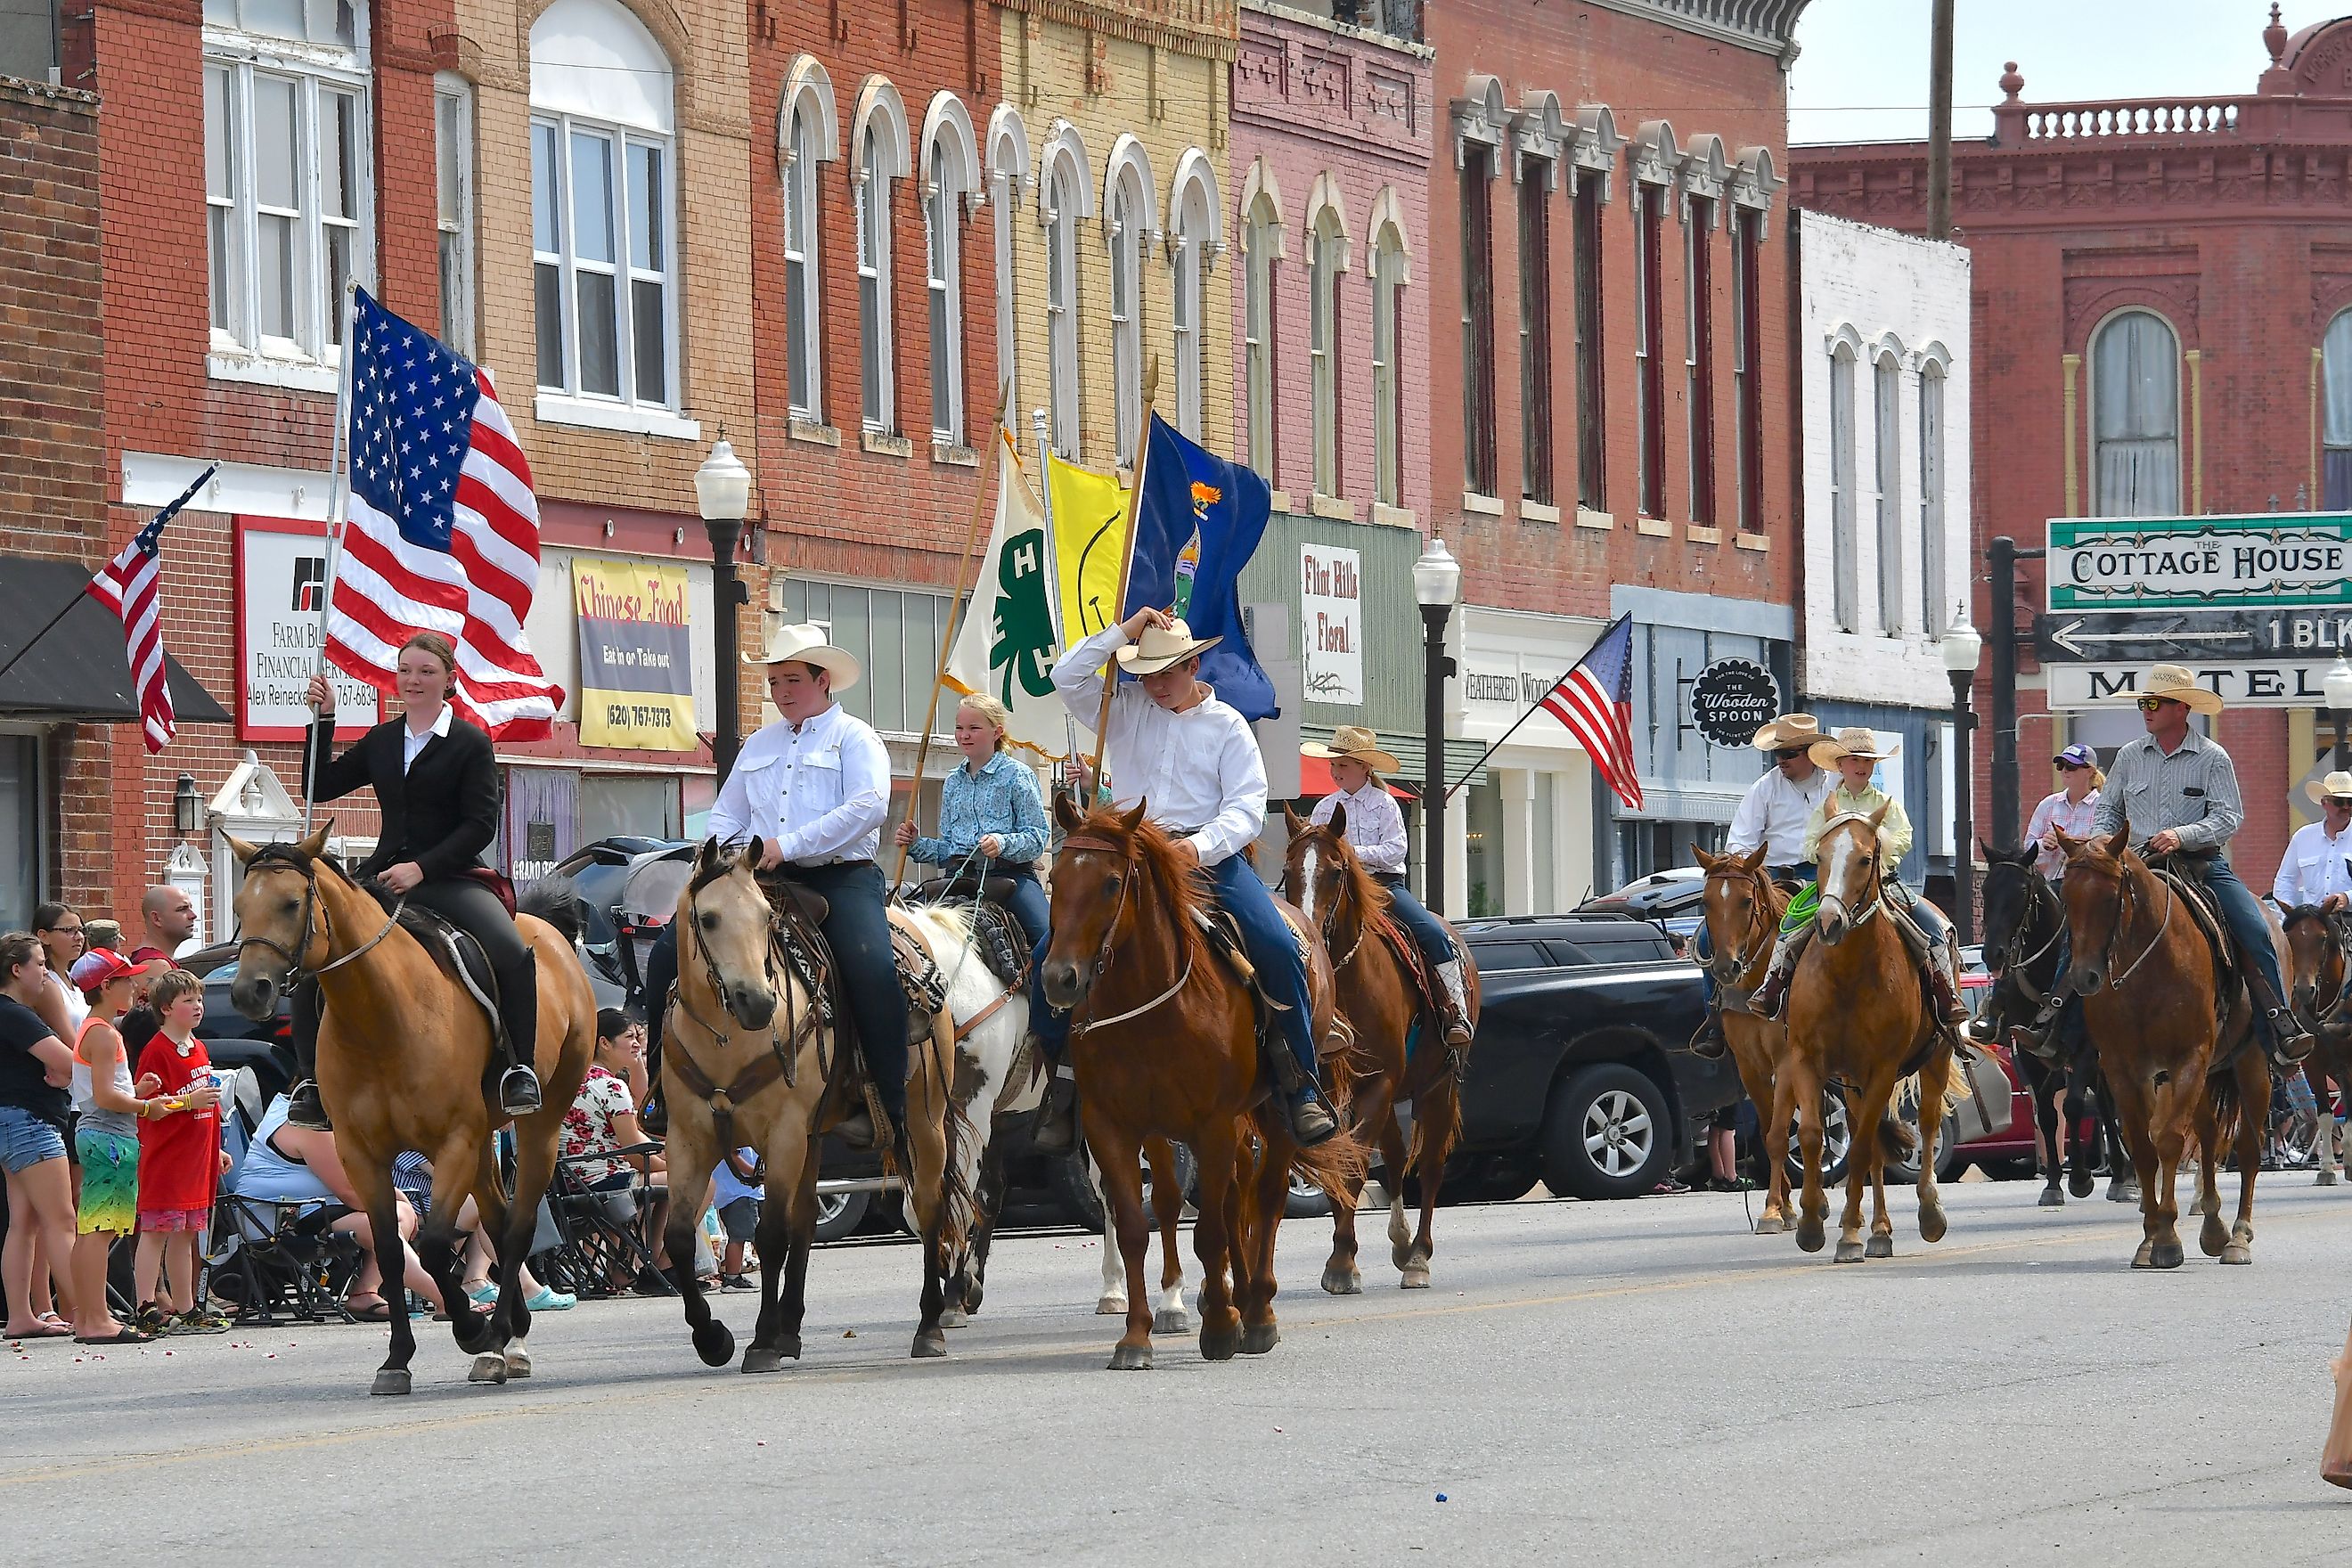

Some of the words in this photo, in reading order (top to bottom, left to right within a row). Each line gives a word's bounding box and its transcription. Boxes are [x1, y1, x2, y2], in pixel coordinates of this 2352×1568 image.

[1014, 542, 1037, 579] H
[2193, 540, 2222, 551] THE
[1304, 555, 1330, 597] Flint
[1333, 559, 1358, 600] Hills
[2070, 551, 2221, 584] COTTAGE
[2233, 547, 2344, 579] HOUSE
[580, 575, 641, 625] Chinese
[648, 580, 683, 627] Food
[273, 622, 304, 648] FARM
[1317, 611, 1350, 654] Floral
[2269, 619, 2281, 648] 1
[2292, 618, 2352, 648] BLK
[603, 645, 617, 666] Eat
[617, 646, 624, 666] in
[625, 653, 635, 666] or
[636, 648, 657, 667] Take
[657, 653, 670, 668] out
[1033, 644, 1058, 679] H
[248, 684, 266, 706] Alex
[337, 684, 377, 706] 767-6834
[2087, 668, 2325, 699] MTEL
[1701, 692, 1768, 708] Wooden
[607, 704, 630, 731] (620)
[632, 705, 671, 729] 767-7373
[1709, 710, 1762, 722] SPOON
